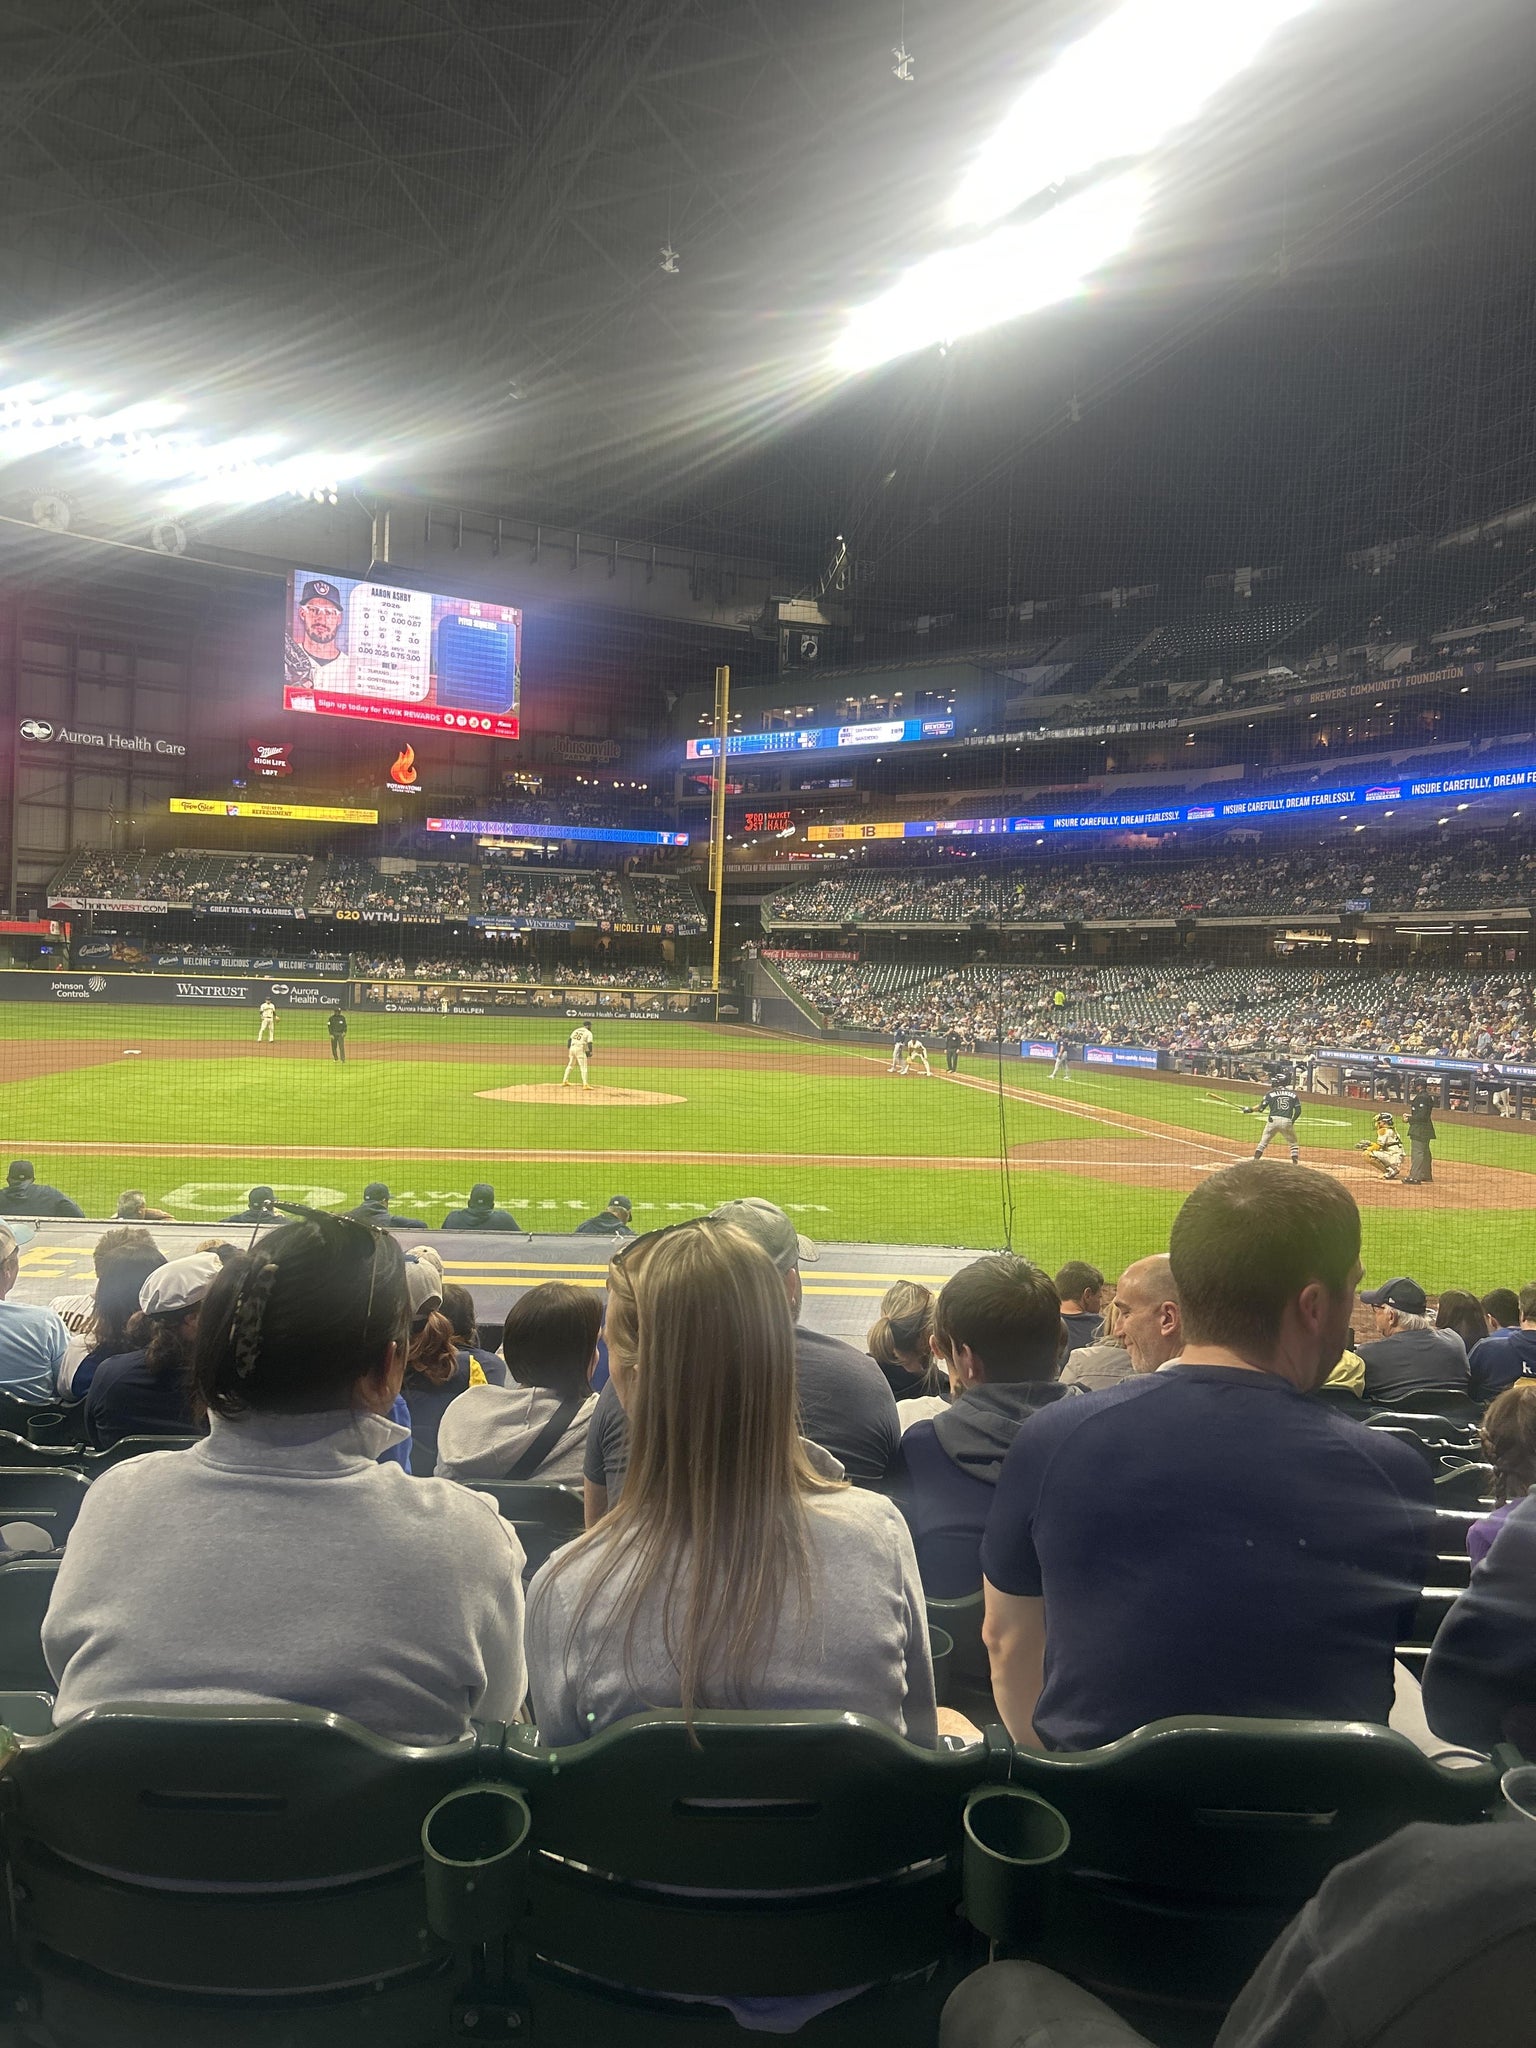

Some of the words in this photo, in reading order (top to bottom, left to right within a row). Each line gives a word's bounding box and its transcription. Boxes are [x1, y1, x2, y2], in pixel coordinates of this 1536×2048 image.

[371, 588, 390, 599] AARON
[392, 592, 411, 602] ASHBY
[1309, 688, 1347, 704] BREWERS
[1350, 679, 1402, 696] COMMUNITY
[1406, 667, 1464, 686] FOUNDATION
[318, 699, 335, 708] Sign
[349, 703, 369, 713] today
[383, 708, 402, 716] KWIK
[404, 711, 441, 721] REWARDS
[56, 728, 104, 746] Aurora
[108, 733, 151, 752] Health
[156, 740, 186, 756] Care
[257, 746, 283, 758] Miller
[386, 783, 421, 791] POTAWATOMI
[1412, 783, 1441, 795] INSURE
[1443, 777, 1492, 792] CAREFULLY,
[1493, 773, 1524, 786] DREAM
[1223, 803, 1246, 815] INSURE
[1248, 800, 1285, 812] CAREFULLY,
[1286, 796, 1310, 808] DREAM
[1311, 792, 1356, 806] FEARLESSLY.
[1054, 818, 1078, 828] INSURE
[1080, 816, 1119, 827] CAREFULLY,
[1121, 814, 1144, 825] DREAM
[1144, 811, 1180, 823] FEARLESSLY.
[860, 826, 876, 837] 1B
[336, 910, 360, 920] 620
[362, 911, 399, 922] WTMJ
[525, 919, 571, 929] WINTRUST
[614, 923, 644, 933] NICOLET
[646, 925, 662, 933] LAW
[79, 944, 110, 956] Culver's
[159, 957, 178, 965] Culver's
[183, 958, 211, 966] WELCOME
[222, 959, 250, 967] DELICIOUS
[254, 960, 273, 968] Culver's
[279, 960, 306, 969] WELCOME
[316, 962, 343, 971] DELICIOUS
[51, 982, 84, 990] Johnson
[176, 983, 246, 996] WINTRUST
[291, 987, 319, 995] Aurora
[290, 994, 318, 1004] Health
[320, 996, 339, 1004] Care
[573, 1032, 583, 1041] 26
[1277, 1096, 1289, 1110] 15
